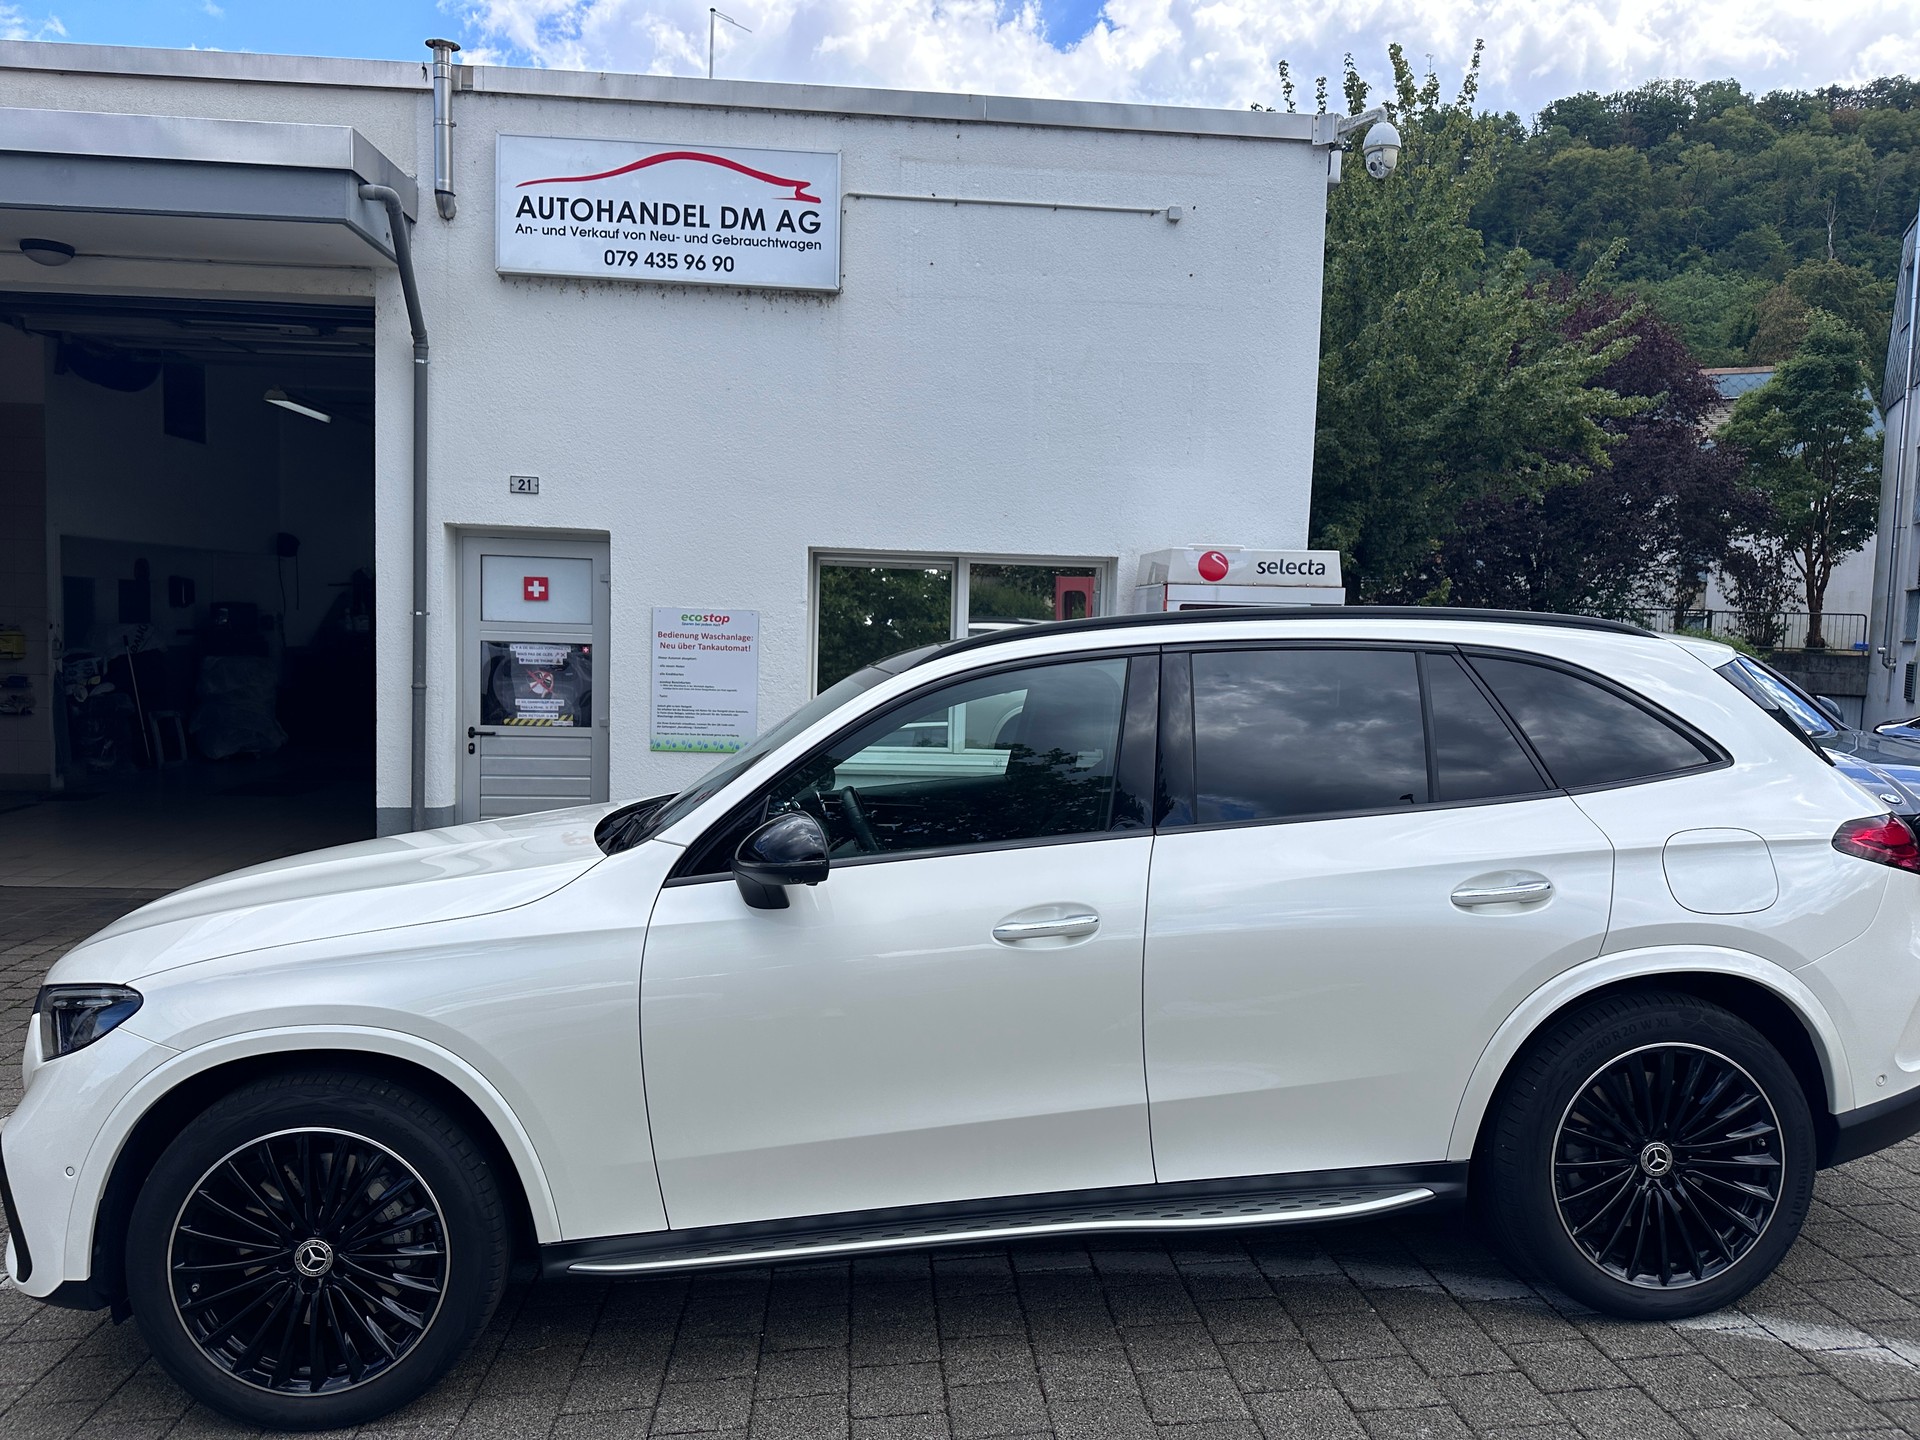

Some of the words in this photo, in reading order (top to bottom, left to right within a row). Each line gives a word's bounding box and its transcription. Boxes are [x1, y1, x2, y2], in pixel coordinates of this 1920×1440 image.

[515, 195, 710, 229] AUTOHANDEL
[720, 206, 766, 231] DM
[775, 209, 822, 234] AG
[515, 223, 538, 235] An-
[541, 225, 566, 237] und
[570, 226, 621, 239] Verkauf
[622, 230, 646, 241] von
[650, 230, 680, 242] Neu-
[684, 233, 708, 244] und
[712, 233, 822, 252] Gebrauchtwagen
[604, 249, 639, 267] 079
[644, 252, 678, 270] 435
[684, 253, 707, 271] 96
[712, 255, 735, 273] 90
[517, 478, 531, 491] 21
[1256, 558, 1326, 576] selecta
[681, 613, 730, 625] ecostop
[657, 631, 699, 641] Bedienung
[700, 632, 754, 643] Waschanlage:
[678, 642, 696, 650] über
[697, 643, 751, 652] Tankautomat!
[1572, 1035, 1611, 1069] 285/40
